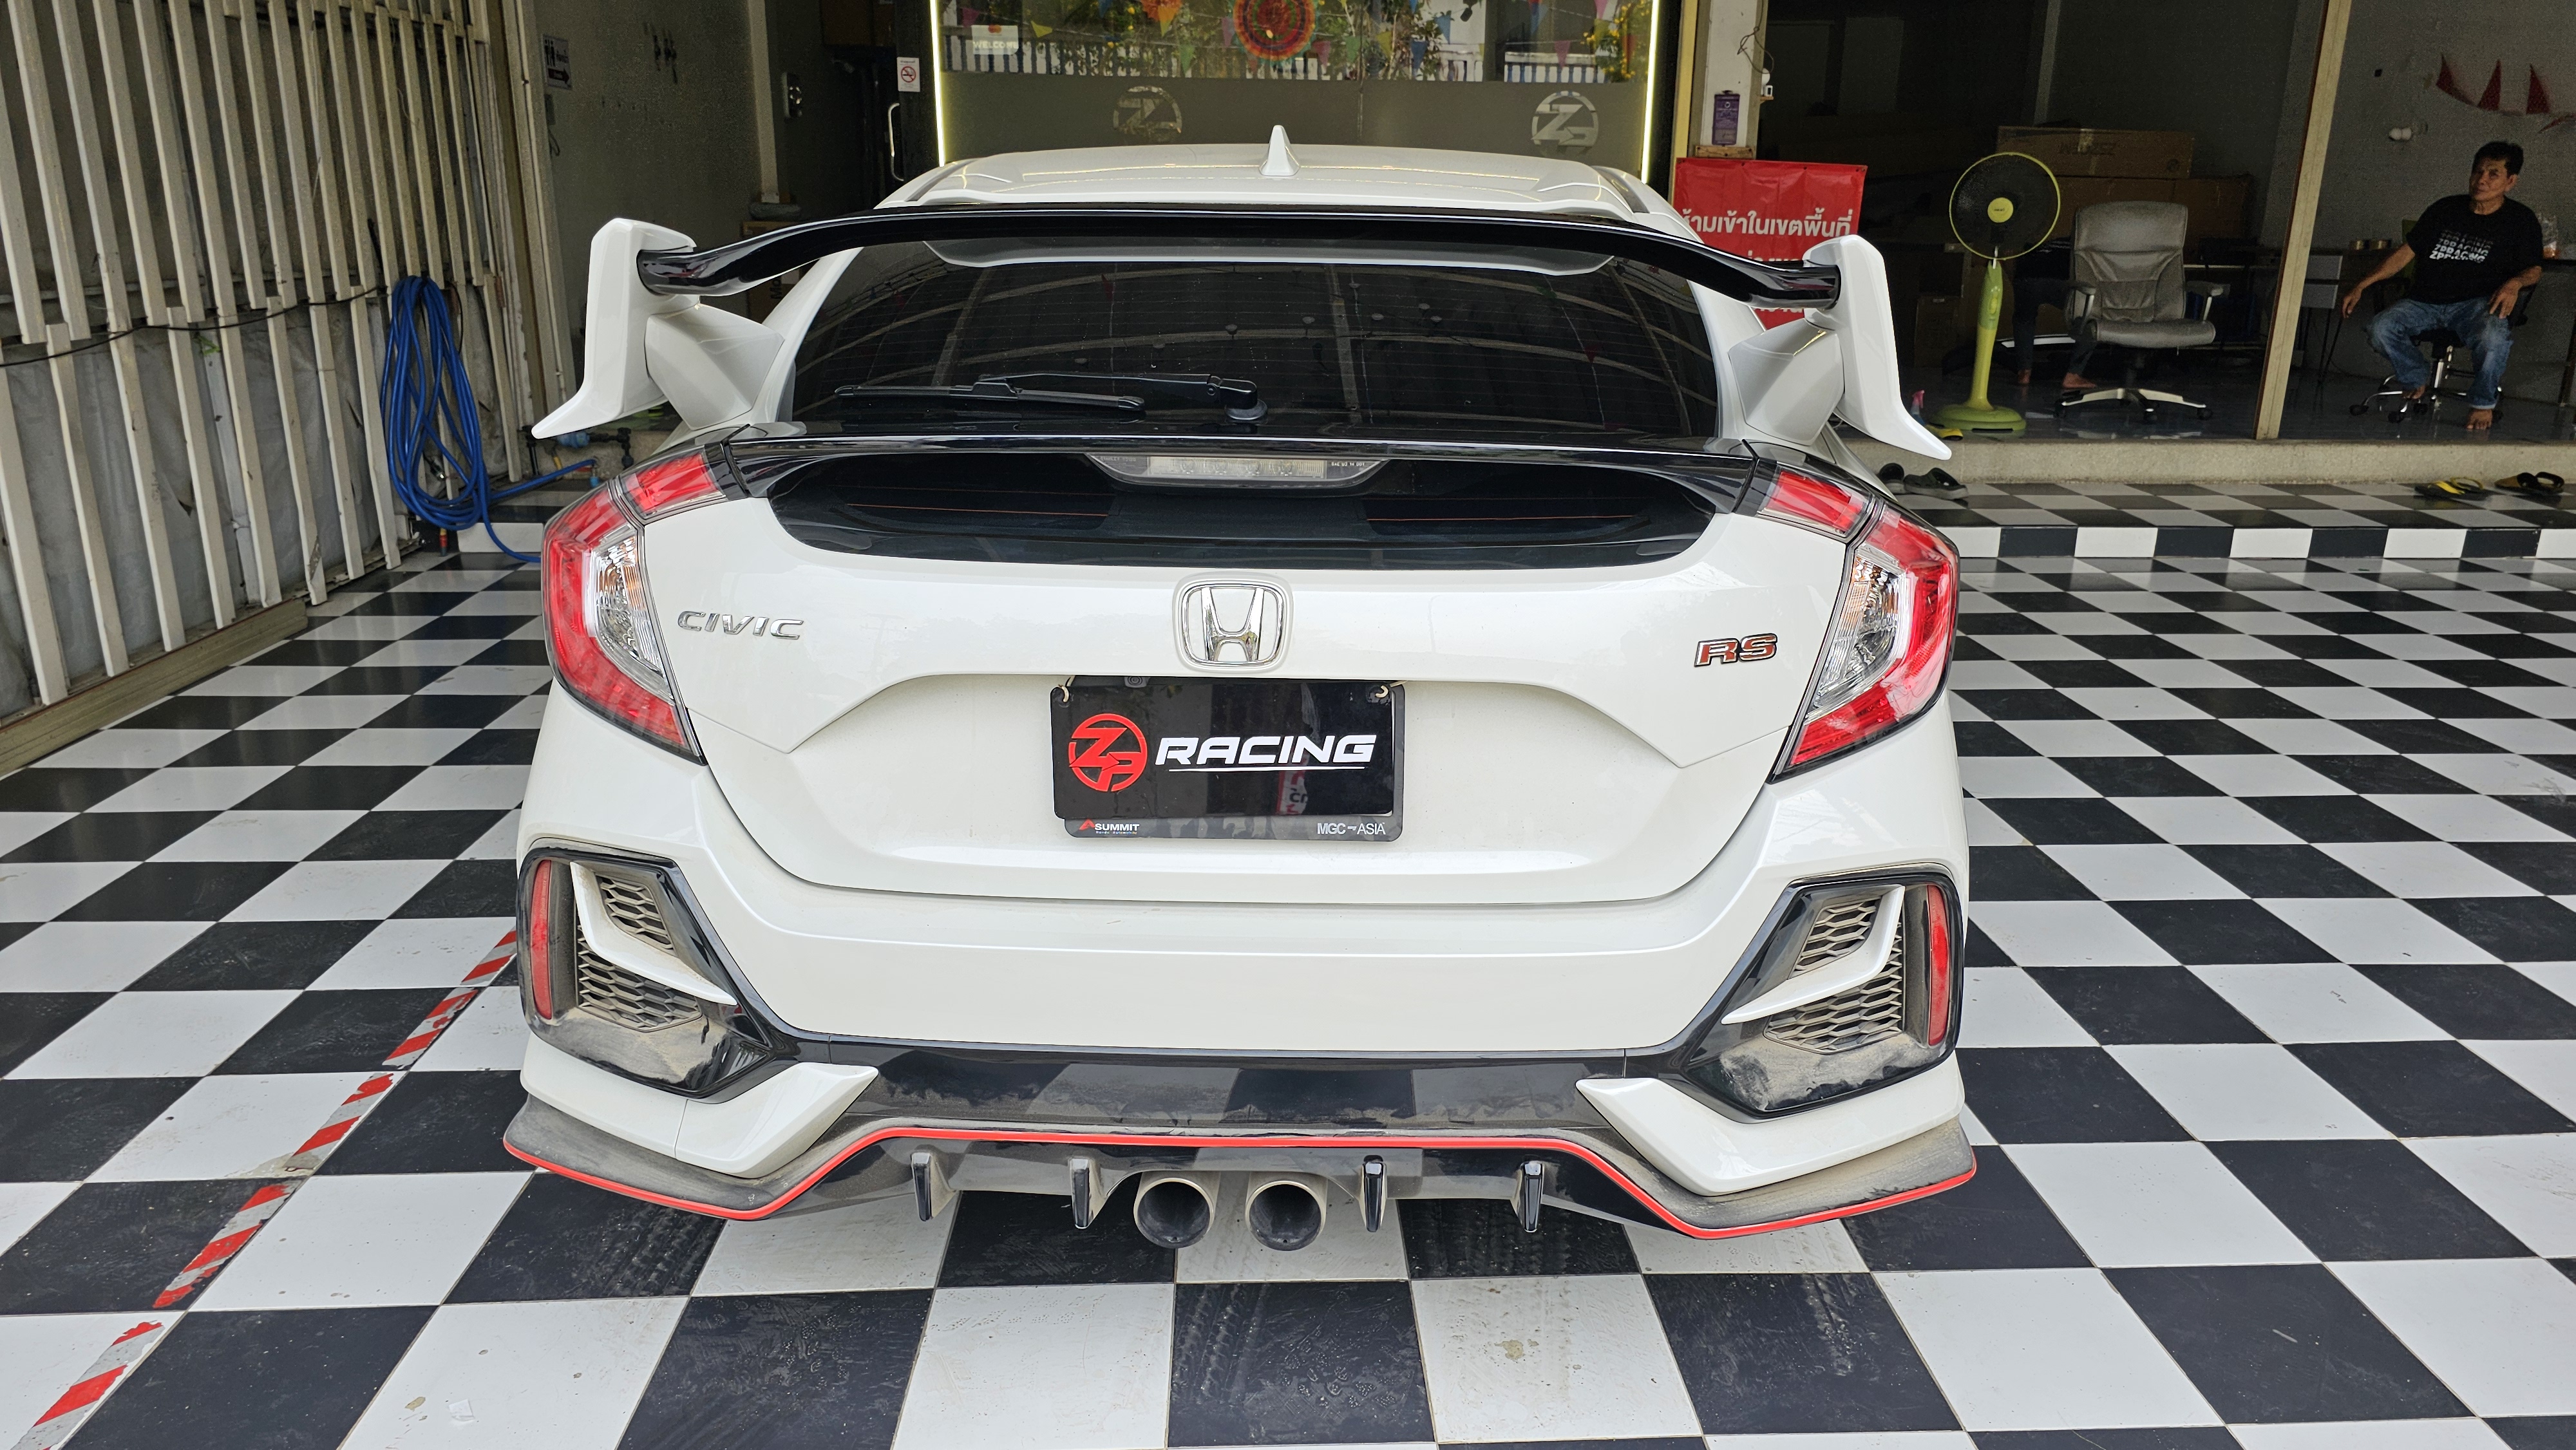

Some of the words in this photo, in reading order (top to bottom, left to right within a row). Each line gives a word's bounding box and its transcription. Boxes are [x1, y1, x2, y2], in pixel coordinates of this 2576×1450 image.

[972, 41, 1018, 49] WELCOME
[677, 610, 804, 640] CIVIC
[1694, 633, 1778, 667] RS
[1155, 735, 1377, 766] RACING
